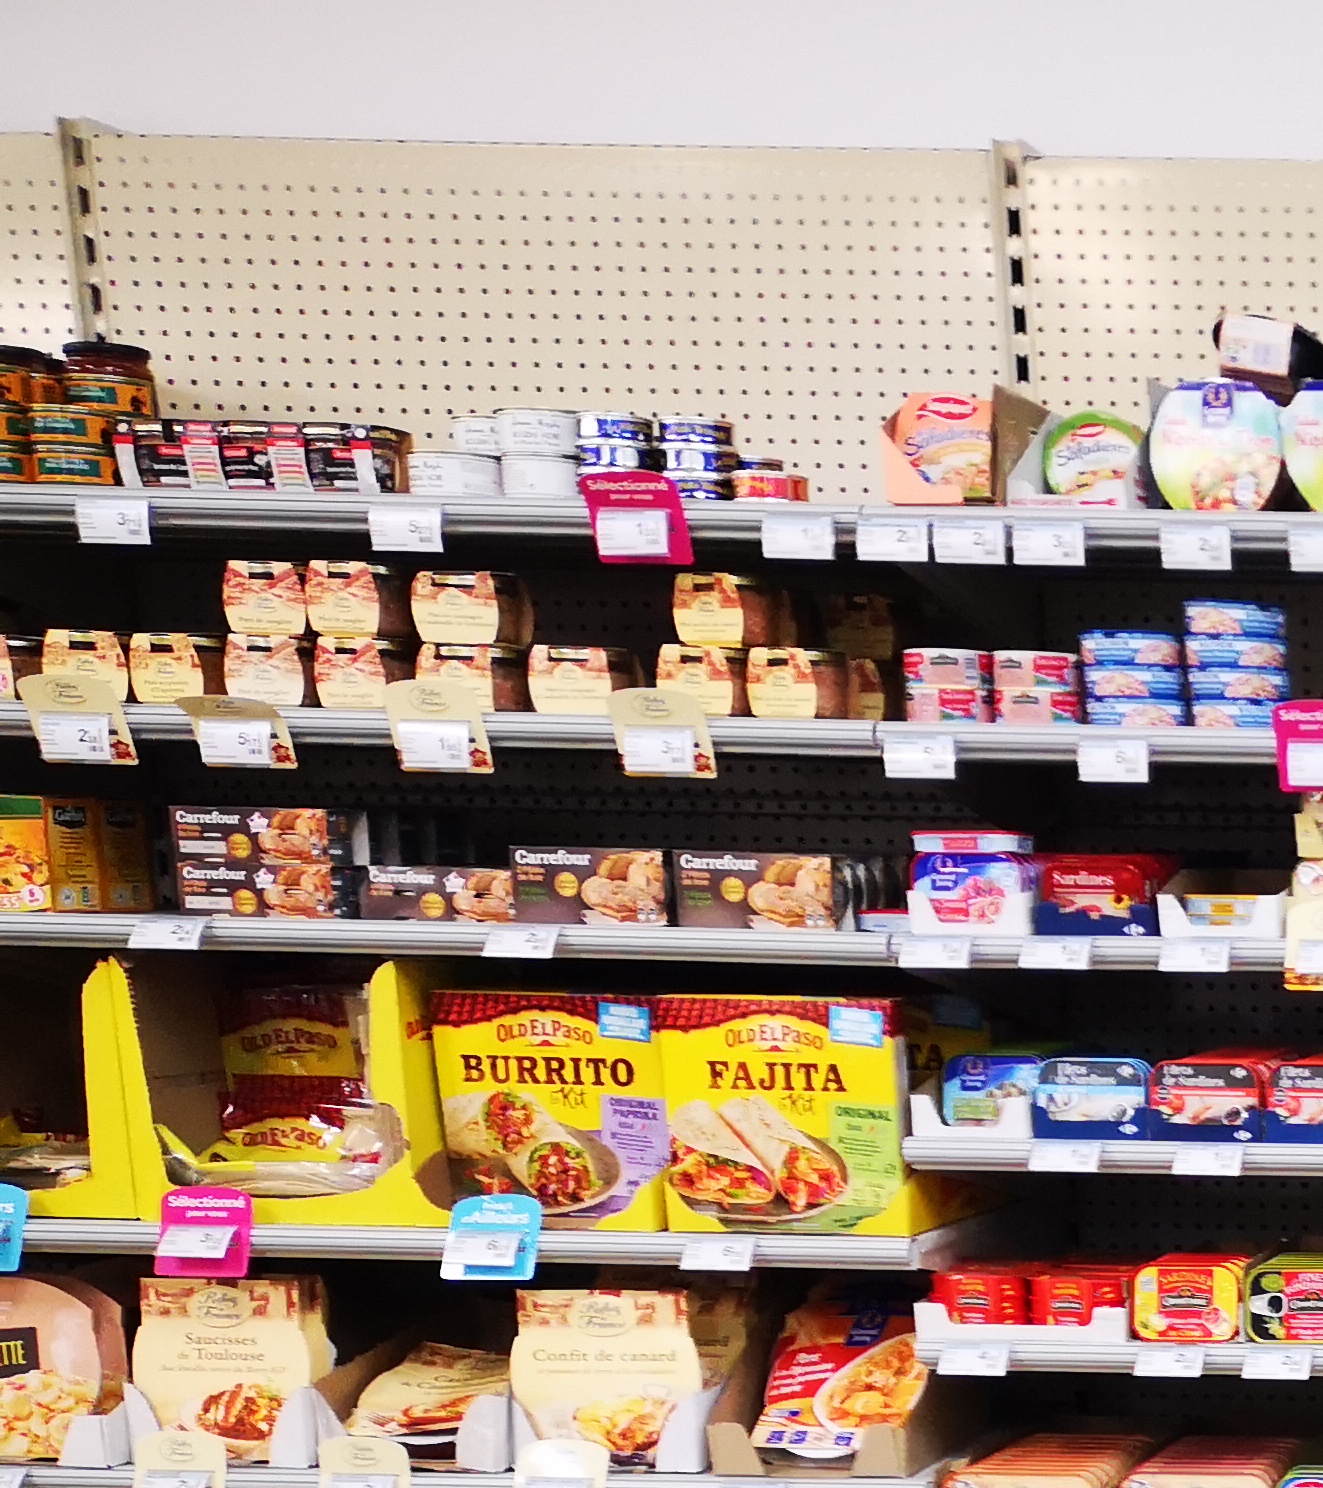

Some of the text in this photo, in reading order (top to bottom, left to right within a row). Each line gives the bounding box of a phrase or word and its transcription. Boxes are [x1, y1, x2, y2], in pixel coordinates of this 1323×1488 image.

[175, 809, 240, 826] Carrefour
[510, 848, 591, 867] Carrefour
[679, 853, 758, 872] Carrefour
[181, 865, 247, 883] Carrefour
[368, 869, 435, 885] Carrefour
[462, 1054, 635, 1087] BURRITO
[706, 1060, 848, 1093] FAJITA
[185, 1333, 258, 1347] Saucisses
[195, 1347, 265, 1362] Toulouse
[532, 1349, 677, 1363] Confit de canard
